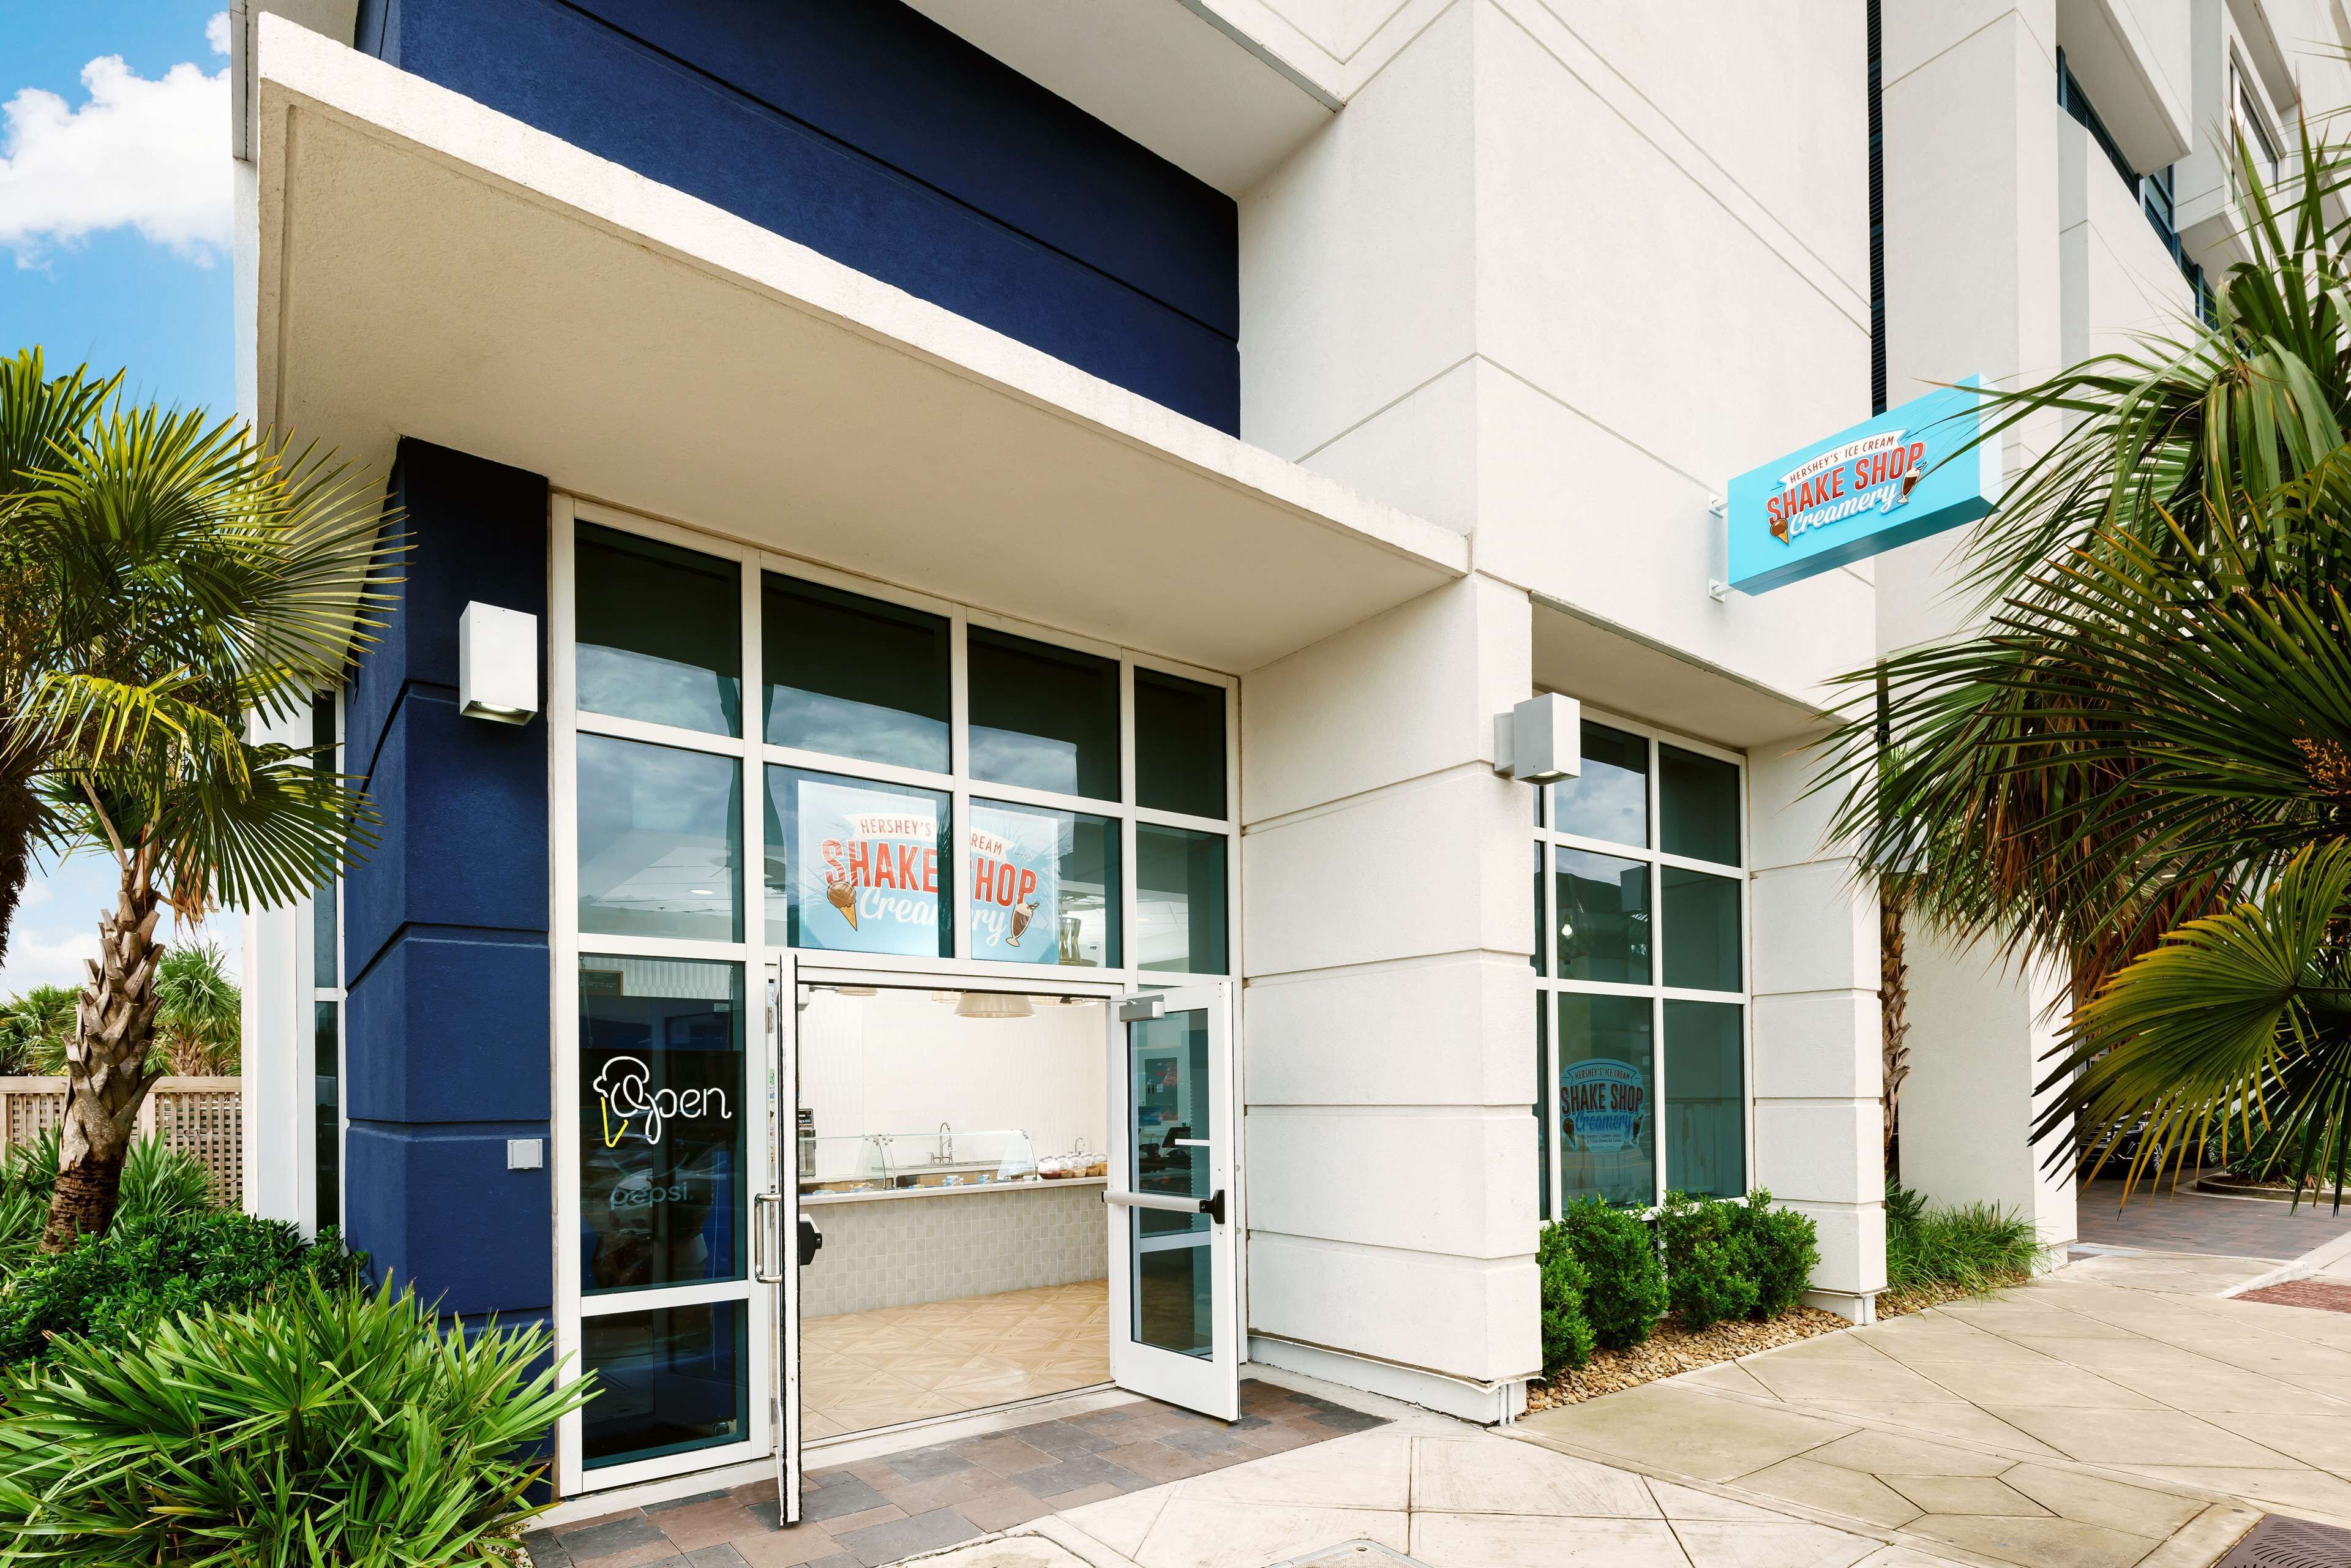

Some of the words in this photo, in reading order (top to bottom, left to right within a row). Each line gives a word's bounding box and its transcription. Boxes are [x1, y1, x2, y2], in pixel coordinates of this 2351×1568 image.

[1790, 453, 1839, 484] HERSHEY'S
[1845, 443, 1860, 456] ICE
[1862, 435, 1894, 453] CREAM
[1767, 467, 1845, 525] SHAKE
[1854, 442, 1926, 490] SHOP
[1790, 483, 1898, 535] Creamery
[860, 818, 931, 837] HERSHEY'S
[970, 833, 1003, 855] REAM
[822, 839, 937, 894] SHAKE
[970, 853, 1037, 907] HOP
[1575, 1068, 1602, 1081] HERSHEY'S
[1614, 1068, 1630, 1081] CREAM
[611, 1074, 732, 1145] Open
[1561, 1083, 1607, 1115] SHAKE
[1610, 1083, 1644, 1113] SHOP
[1575, 1111, 1632, 1138] Creamery
[610, 1180, 688, 1210] pepsi
